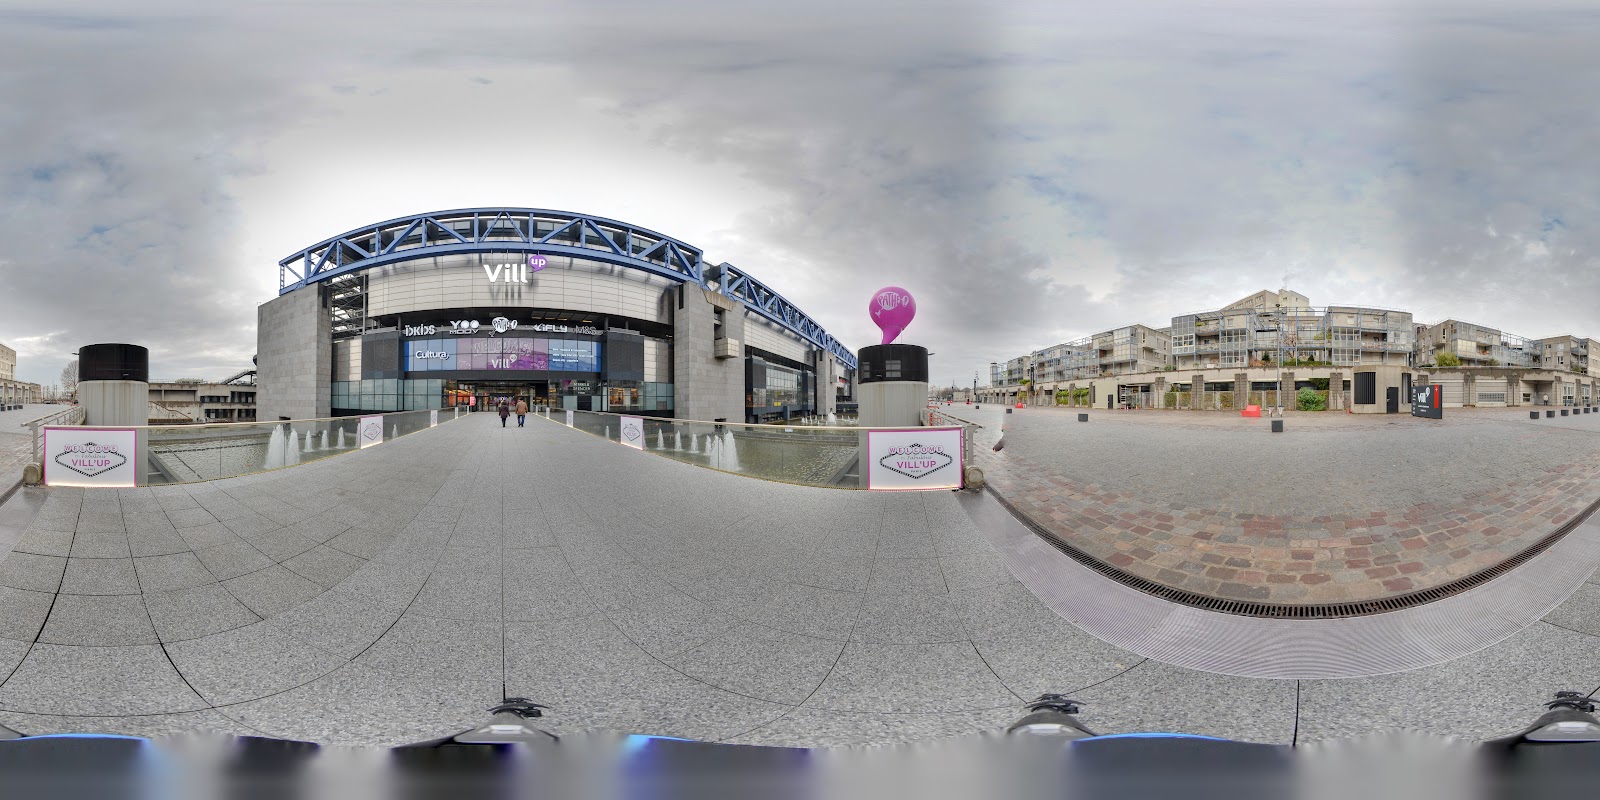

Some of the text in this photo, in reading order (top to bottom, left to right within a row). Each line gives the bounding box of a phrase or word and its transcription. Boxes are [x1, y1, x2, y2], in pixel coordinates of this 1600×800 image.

[483, 258, 546, 283] Vill up
[491, 358, 510, 369] Vill
[64, 444, 117, 452] WELCOME
[71, 459, 111, 467] VILL'UP
[896, 460, 937, 469] VILL'UP
